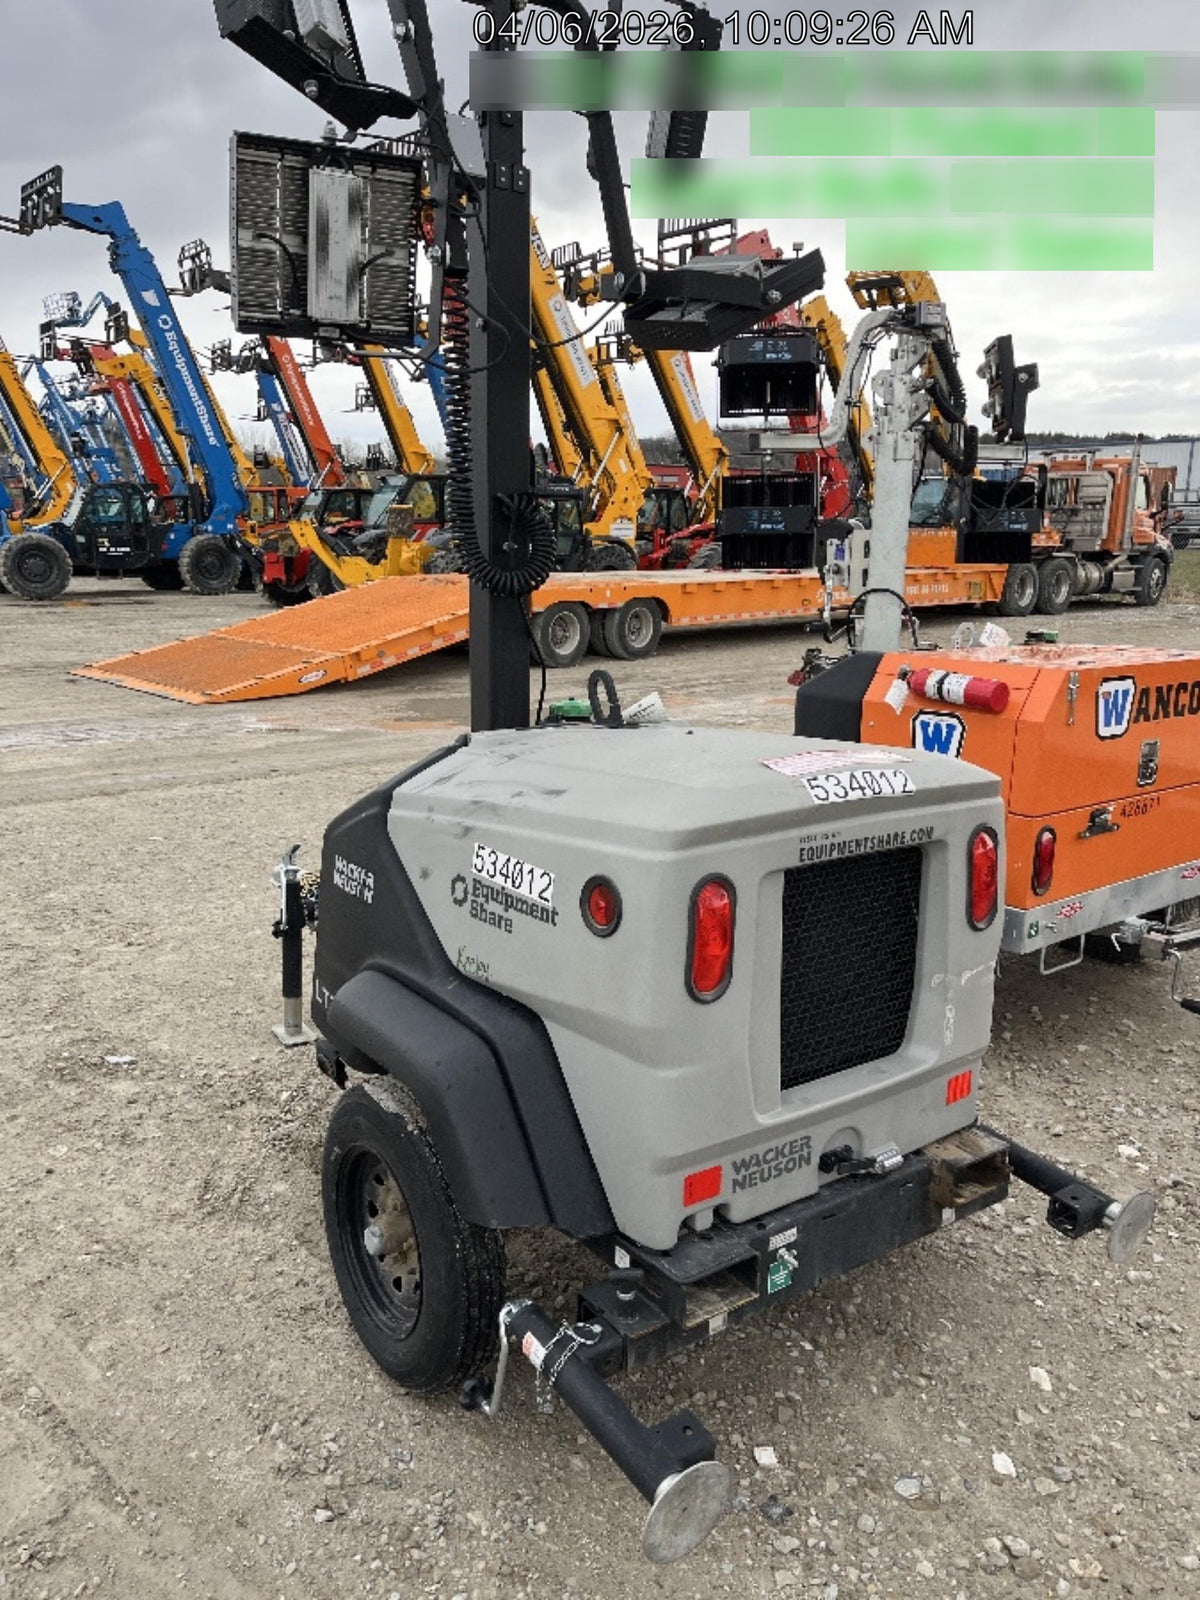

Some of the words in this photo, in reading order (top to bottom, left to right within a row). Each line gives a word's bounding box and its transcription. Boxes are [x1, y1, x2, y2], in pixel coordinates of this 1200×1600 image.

[919, 719, 958, 756] W
[806, 770, 914, 801] 534012
[799, 825, 935, 864] EQUIPMENTSHARE.COM
[474, 844, 553, 903] 534012
[469, 898, 513, 934] Share
[470, 878, 559, 927] Equipment
[731, 1135, 813, 1175] WACKER
[731, 1151, 812, 1194] NEUSON
